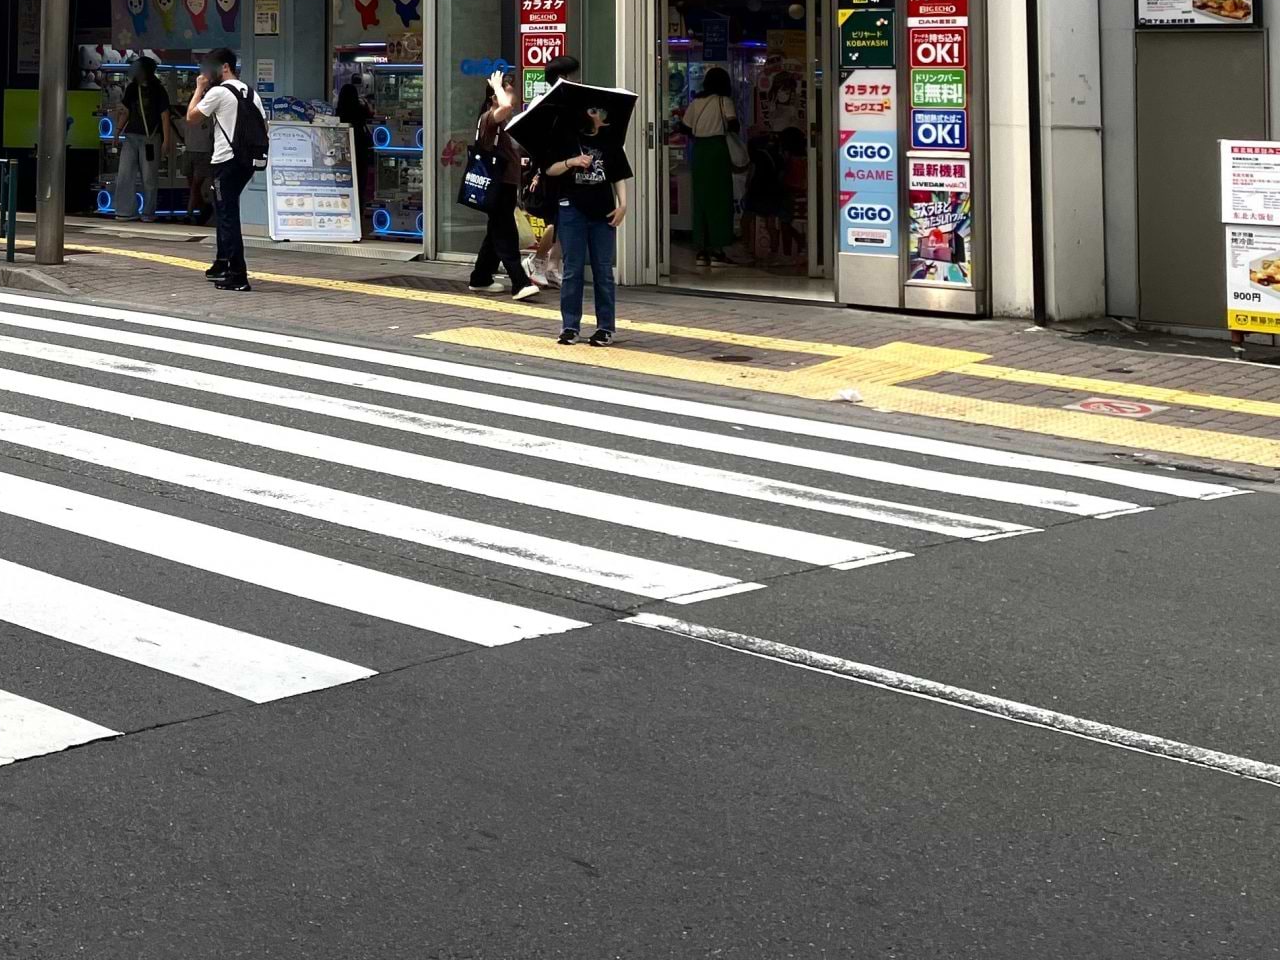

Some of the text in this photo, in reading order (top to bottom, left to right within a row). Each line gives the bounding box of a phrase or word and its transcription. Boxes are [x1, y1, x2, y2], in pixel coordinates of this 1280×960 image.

[522, 0, 565, 11] カラオケ
[929, 33, 961, 43] 持ち込み
[527, 46, 559, 64] OK!
[916, 43, 960, 63] OK!
[526, 72, 545, 80] ドリン
[915, 74, 961, 82] ドリンクバー
[845, 84, 891, 95] カラオケ
[925, 83, 963, 104] 無料!
[845, 102, 892, 112] ビッグエコー
[917, 123, 961, 145] OK!
[846, 145, 890, 159] GiGO
[856, 169, 894, 181] GAME
[912, 163, 966, 178] 最新機種
[847, 206, 891, 222] GiGO
[1233, 291, 1261, 303] 900円
